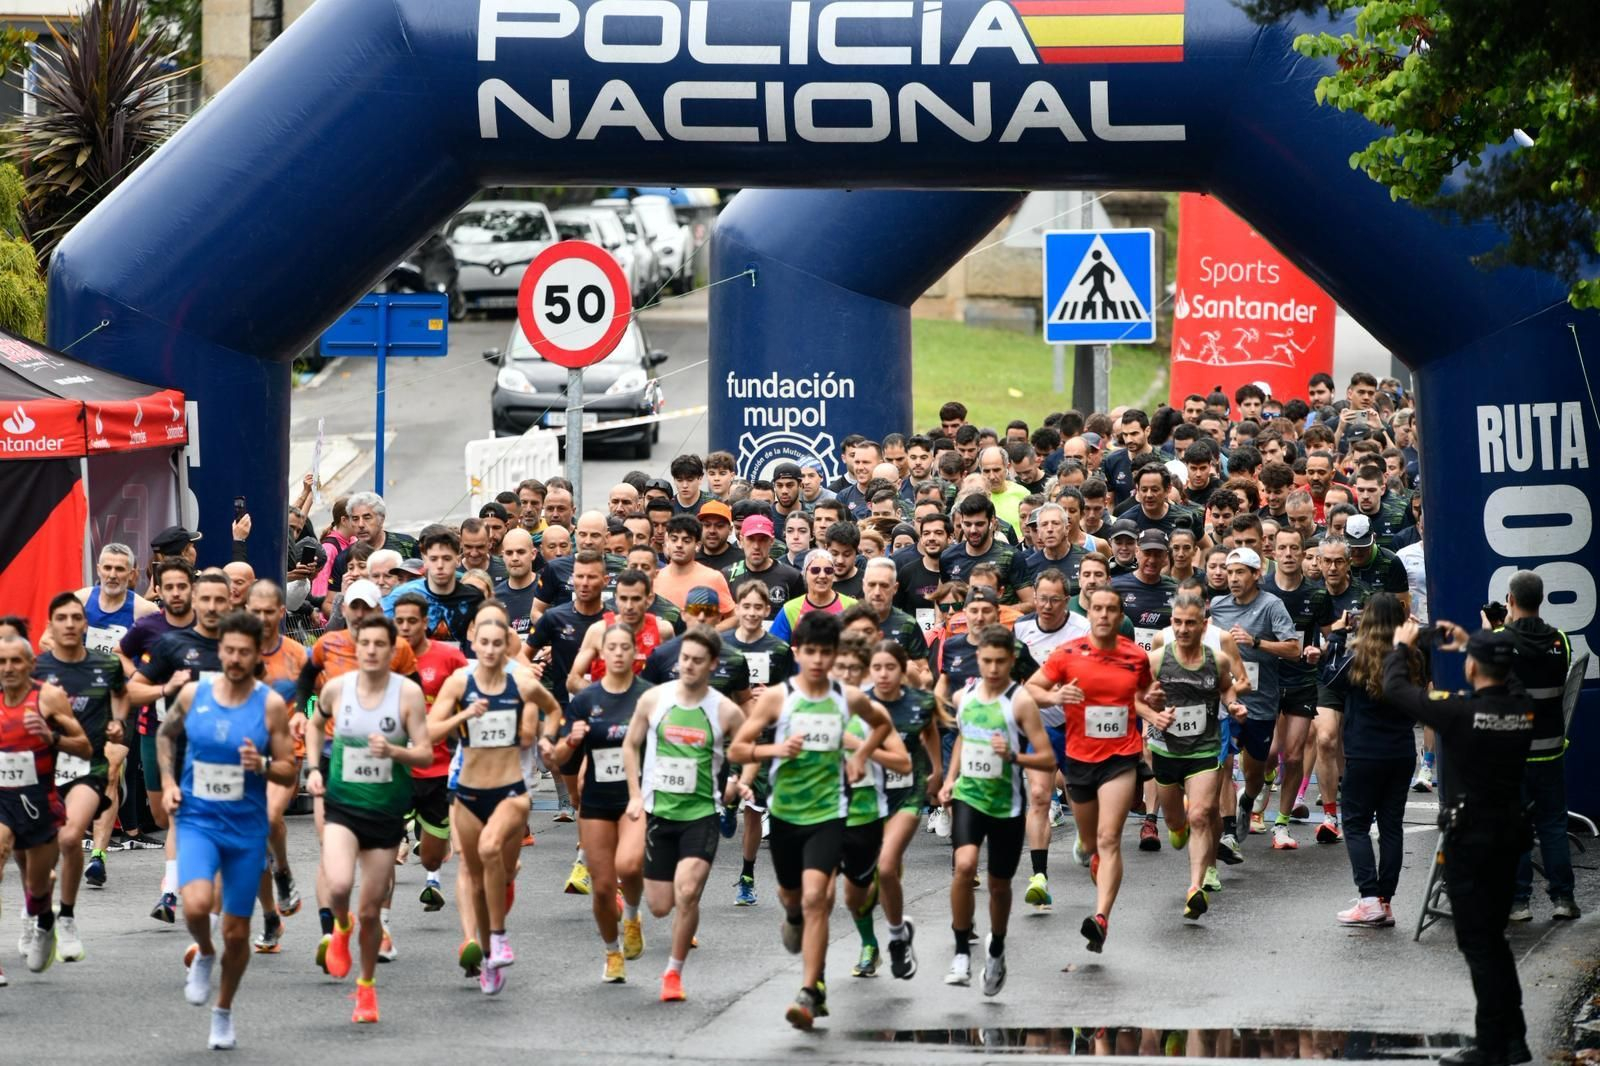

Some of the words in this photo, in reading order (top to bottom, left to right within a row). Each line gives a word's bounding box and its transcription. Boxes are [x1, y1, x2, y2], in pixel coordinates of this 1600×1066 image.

[477, 78, 1187, 143] NACIONAL
[1200, 256, 1280, 288] Sports
[544, 284, 606, 324] 50
[1192, 295, 1317, 324] Santander
[726, 371, 855, 398] fundación
[744, 400, 826, 432] mupol
[1476, 400, 1589, 473] RUTA
[750, 455, 765, 486] ndación
[1095, 722, 1119, 733] 166
[1175, 721, 1197, 732] 181
[481, 729, 506, 741] 275
[803, 732, 829, 743] 449
[354, 766, 380, 777] 461
[967, 761, 991, 773] 150
[0, 769, 24, 780] 737
[661, 774, 685, 786] 788
[205, 782, 231, 795] 165
